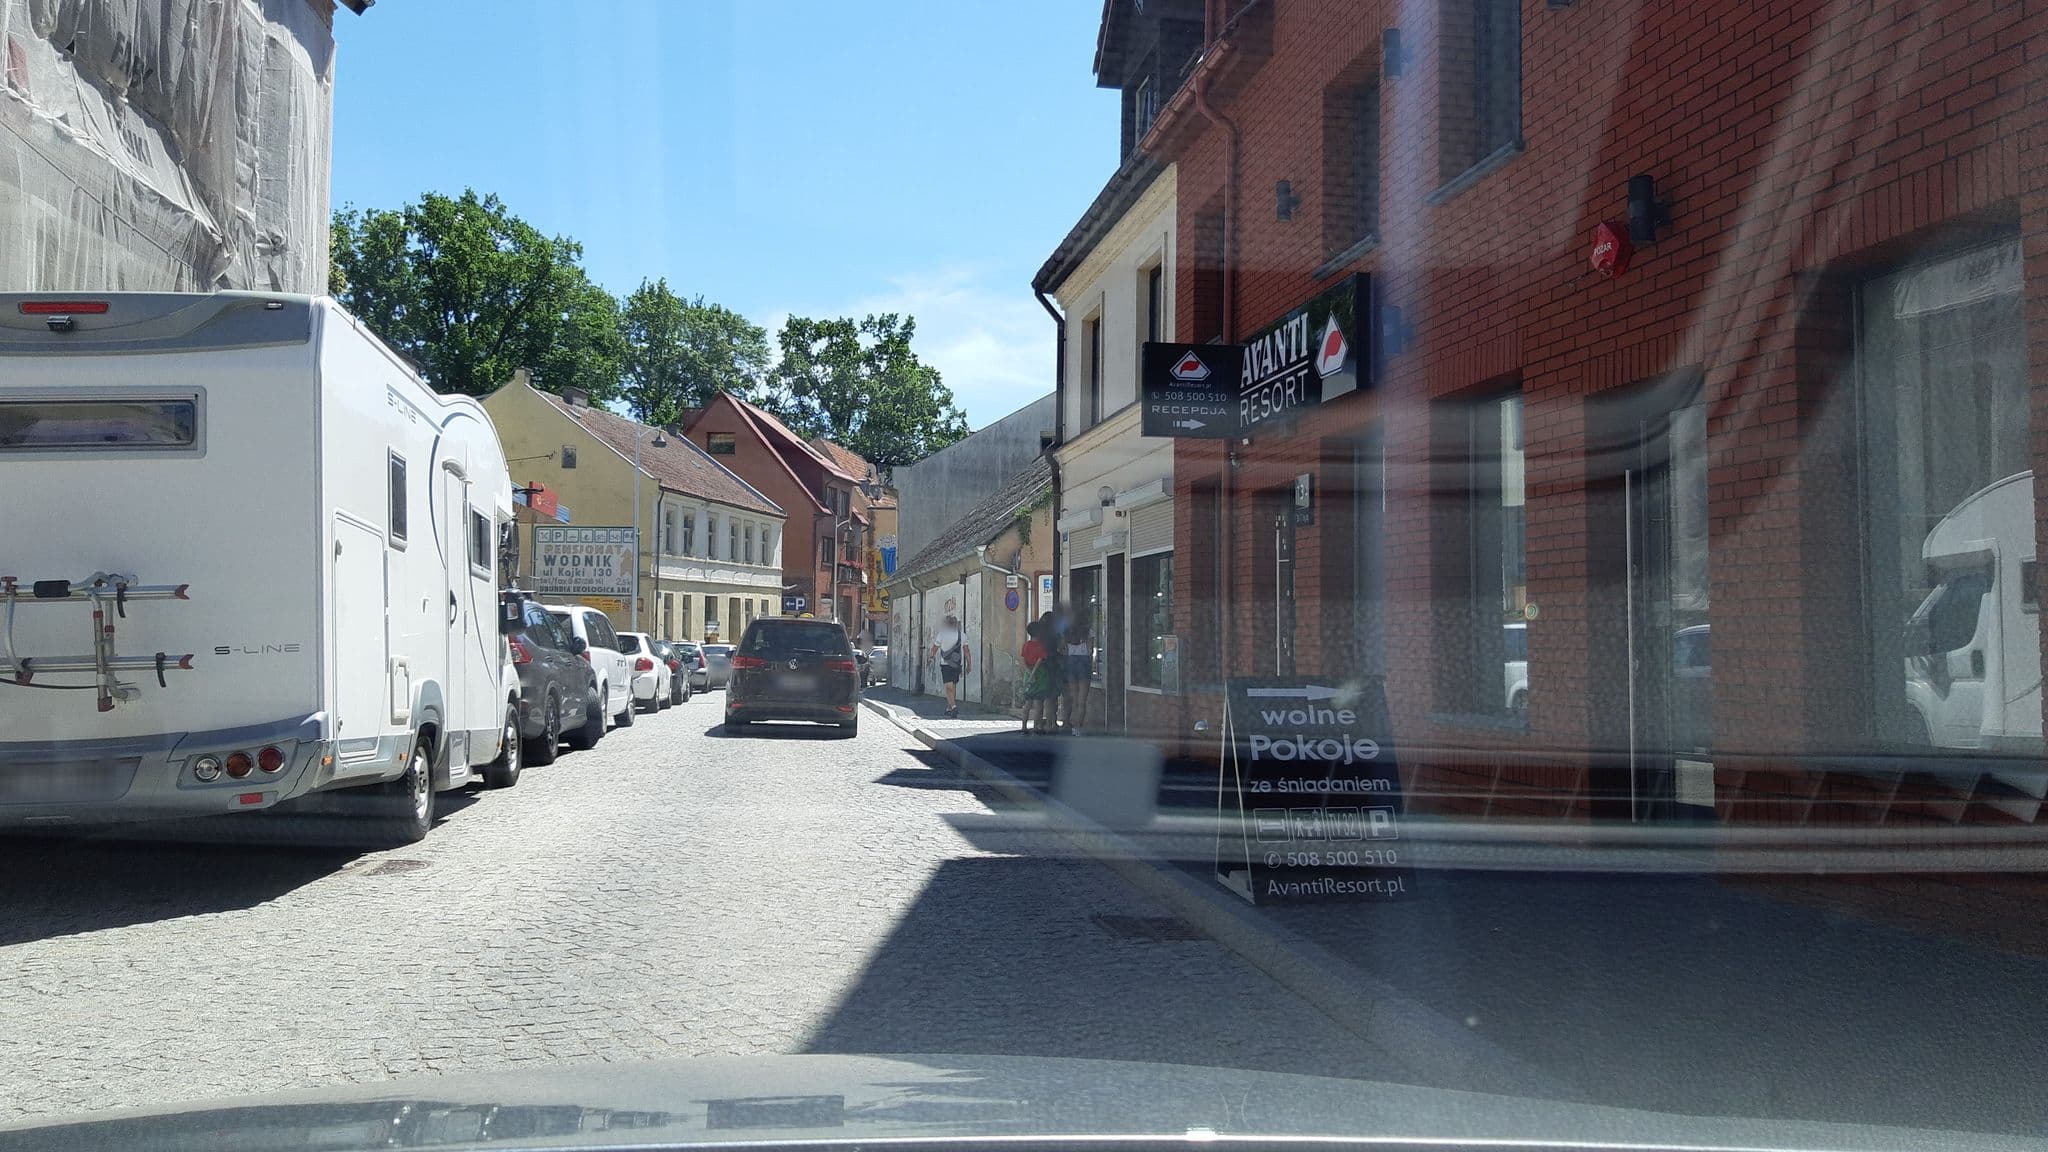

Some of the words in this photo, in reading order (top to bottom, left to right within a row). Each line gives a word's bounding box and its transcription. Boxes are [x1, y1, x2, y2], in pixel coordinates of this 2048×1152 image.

[1240, 312, 1309, 388] AVANTI
[1165, 391, 1184, 401] 508
[1187, 392, 1206, 401] 500
[1208, 393, 1227, 402] 510
[1240, 368, 1309, 428] RESORT
[387, 391, 417, 424] S-LINE
[1151, 405, 1227, 415] RECEPCJA
[543, 555, 612, 567] WODNIK
[543, 567, 553, 577] ul
[593, 568, 612, 577] 130
[795, 598, 805, 610] P
[214, 644, 300, 655] S-LINE
[1261, 704, 1357, 726] wolne
[1250, 733, 1380, 765] Pokoje
[1250, 780, 1272, 793] ze
[1278, 776, 1391, 793] śniadaniem
[1369, 809, 1390, 837] P
[1287, 852, 1320, 867] 508
[1326, 851, 1358, 866] 500
[1365, 850, 1397, 865] 510
[1267, 876, 1406, 896] AvantiResort.pl
